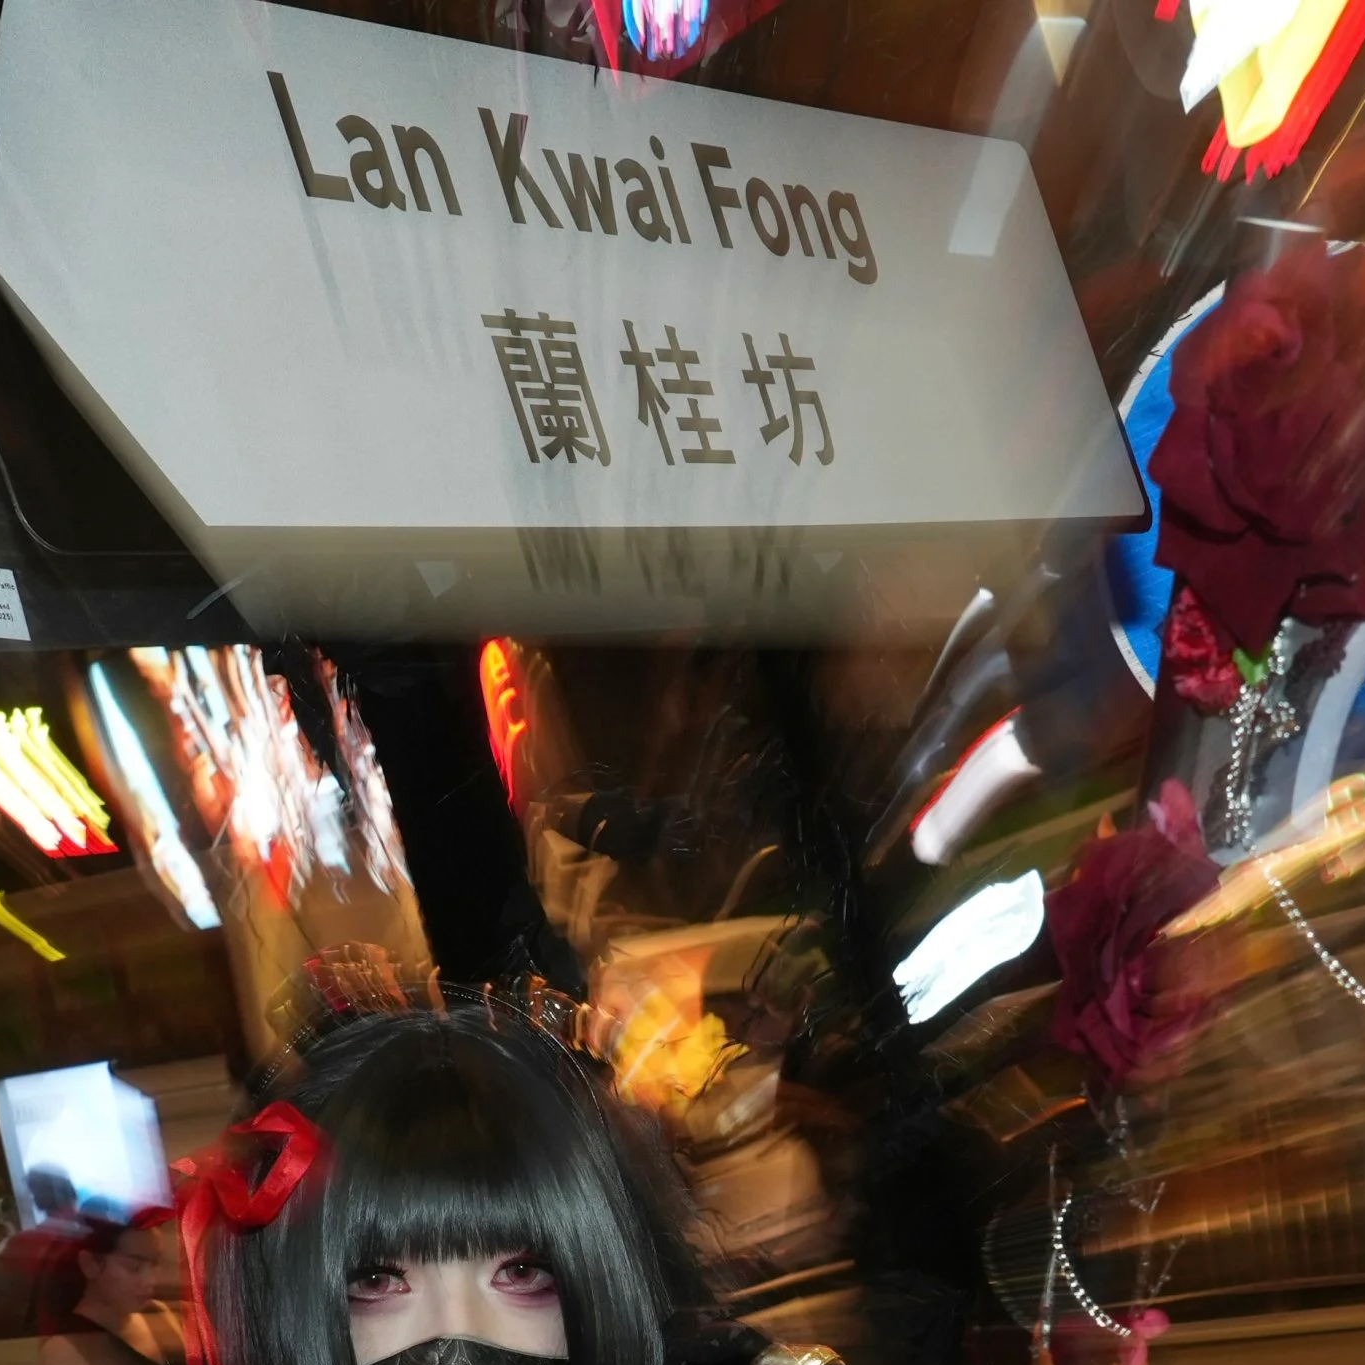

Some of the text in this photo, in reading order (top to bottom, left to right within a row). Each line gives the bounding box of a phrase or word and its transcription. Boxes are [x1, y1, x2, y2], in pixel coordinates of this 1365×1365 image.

[266, 70, 879, 286] Lan Kwai Fong
[480, 308, 835, 468] 蘭桂坊
